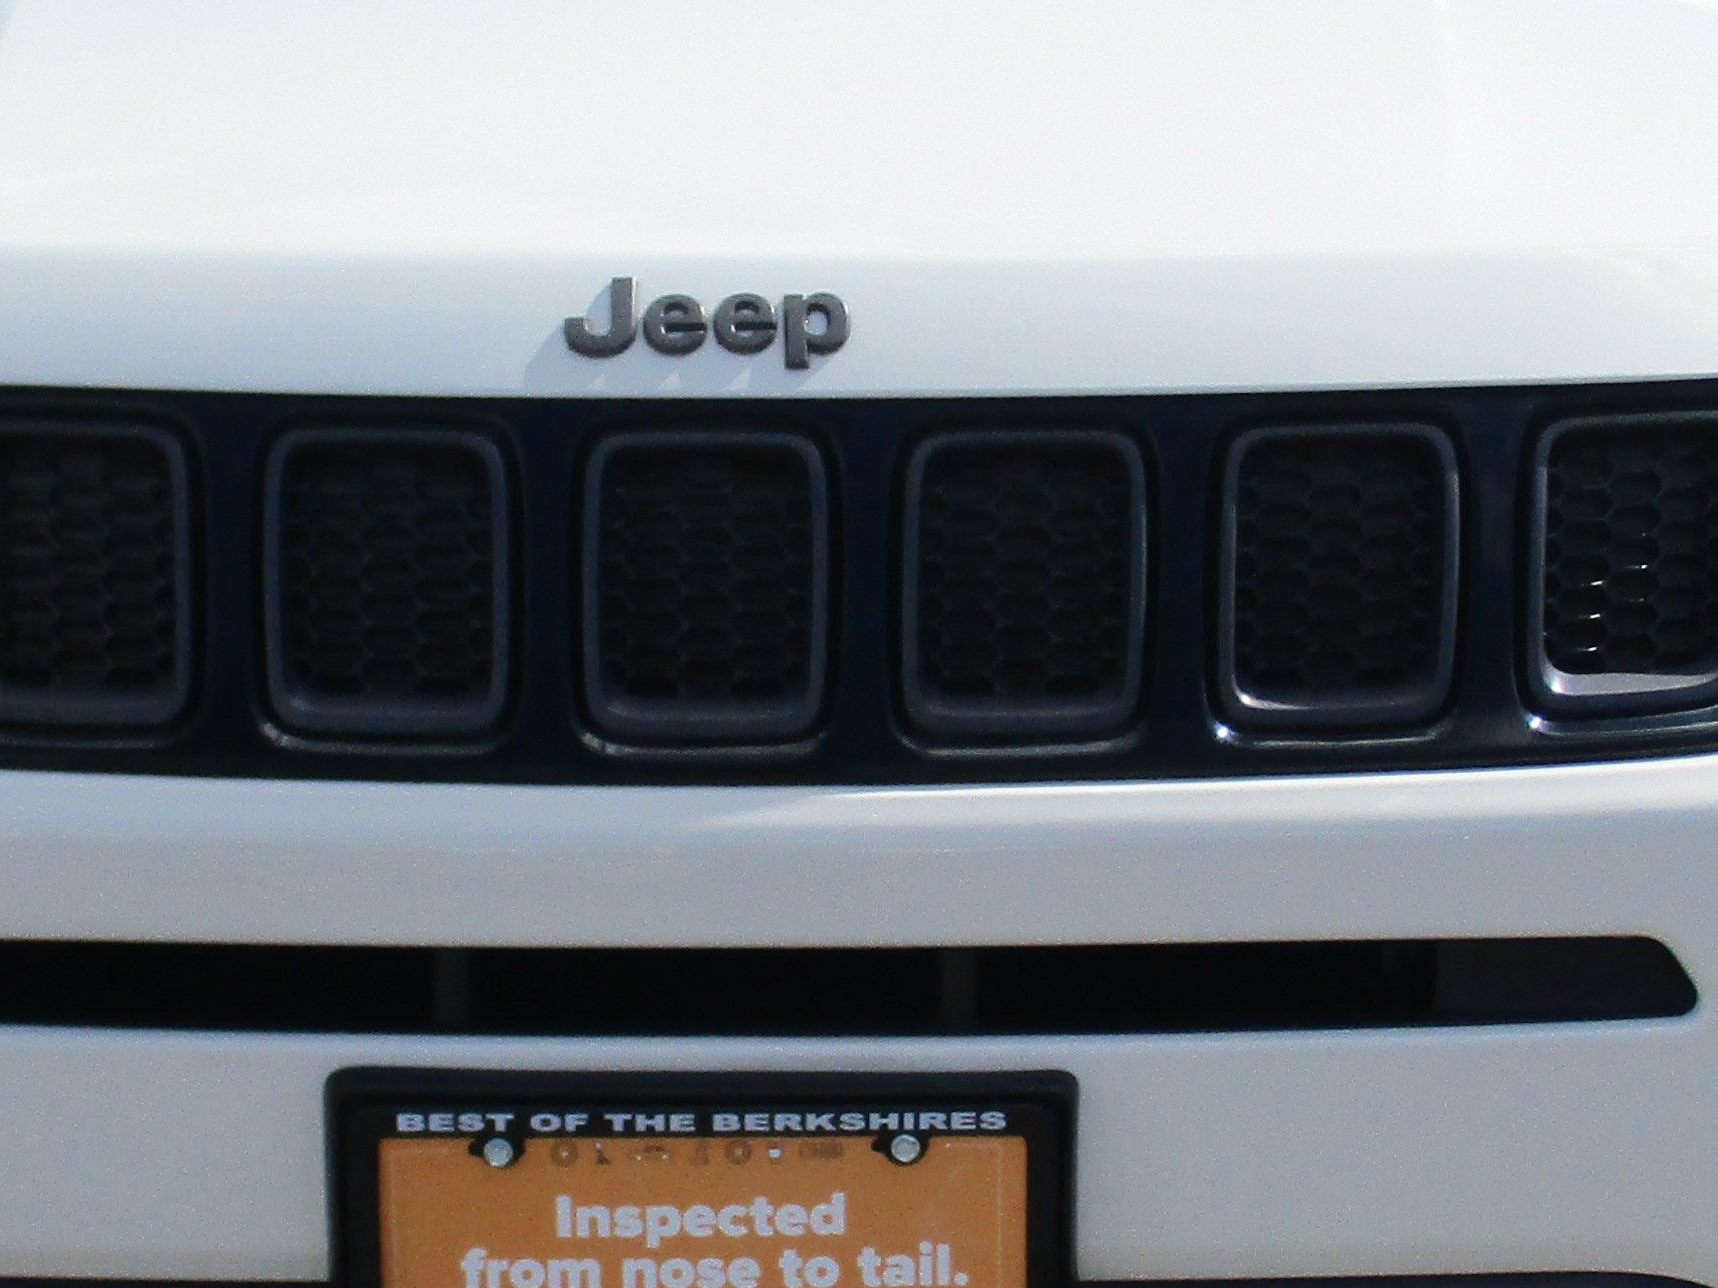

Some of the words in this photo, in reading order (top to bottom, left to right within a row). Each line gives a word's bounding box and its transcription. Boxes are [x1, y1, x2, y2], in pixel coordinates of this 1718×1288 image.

[564, 277, 850, 369] Jeep
[396, 1113, 515, 1132] BEST
[530, 1113, 589, 1132] OF
[604, 1112, 696, 1132] THE
[712, 1110, 1008, 1131] BERKSHIRES
[555, 1191, 847, 1248] Inspected
[856, 1240, 970, 1288] tail.
